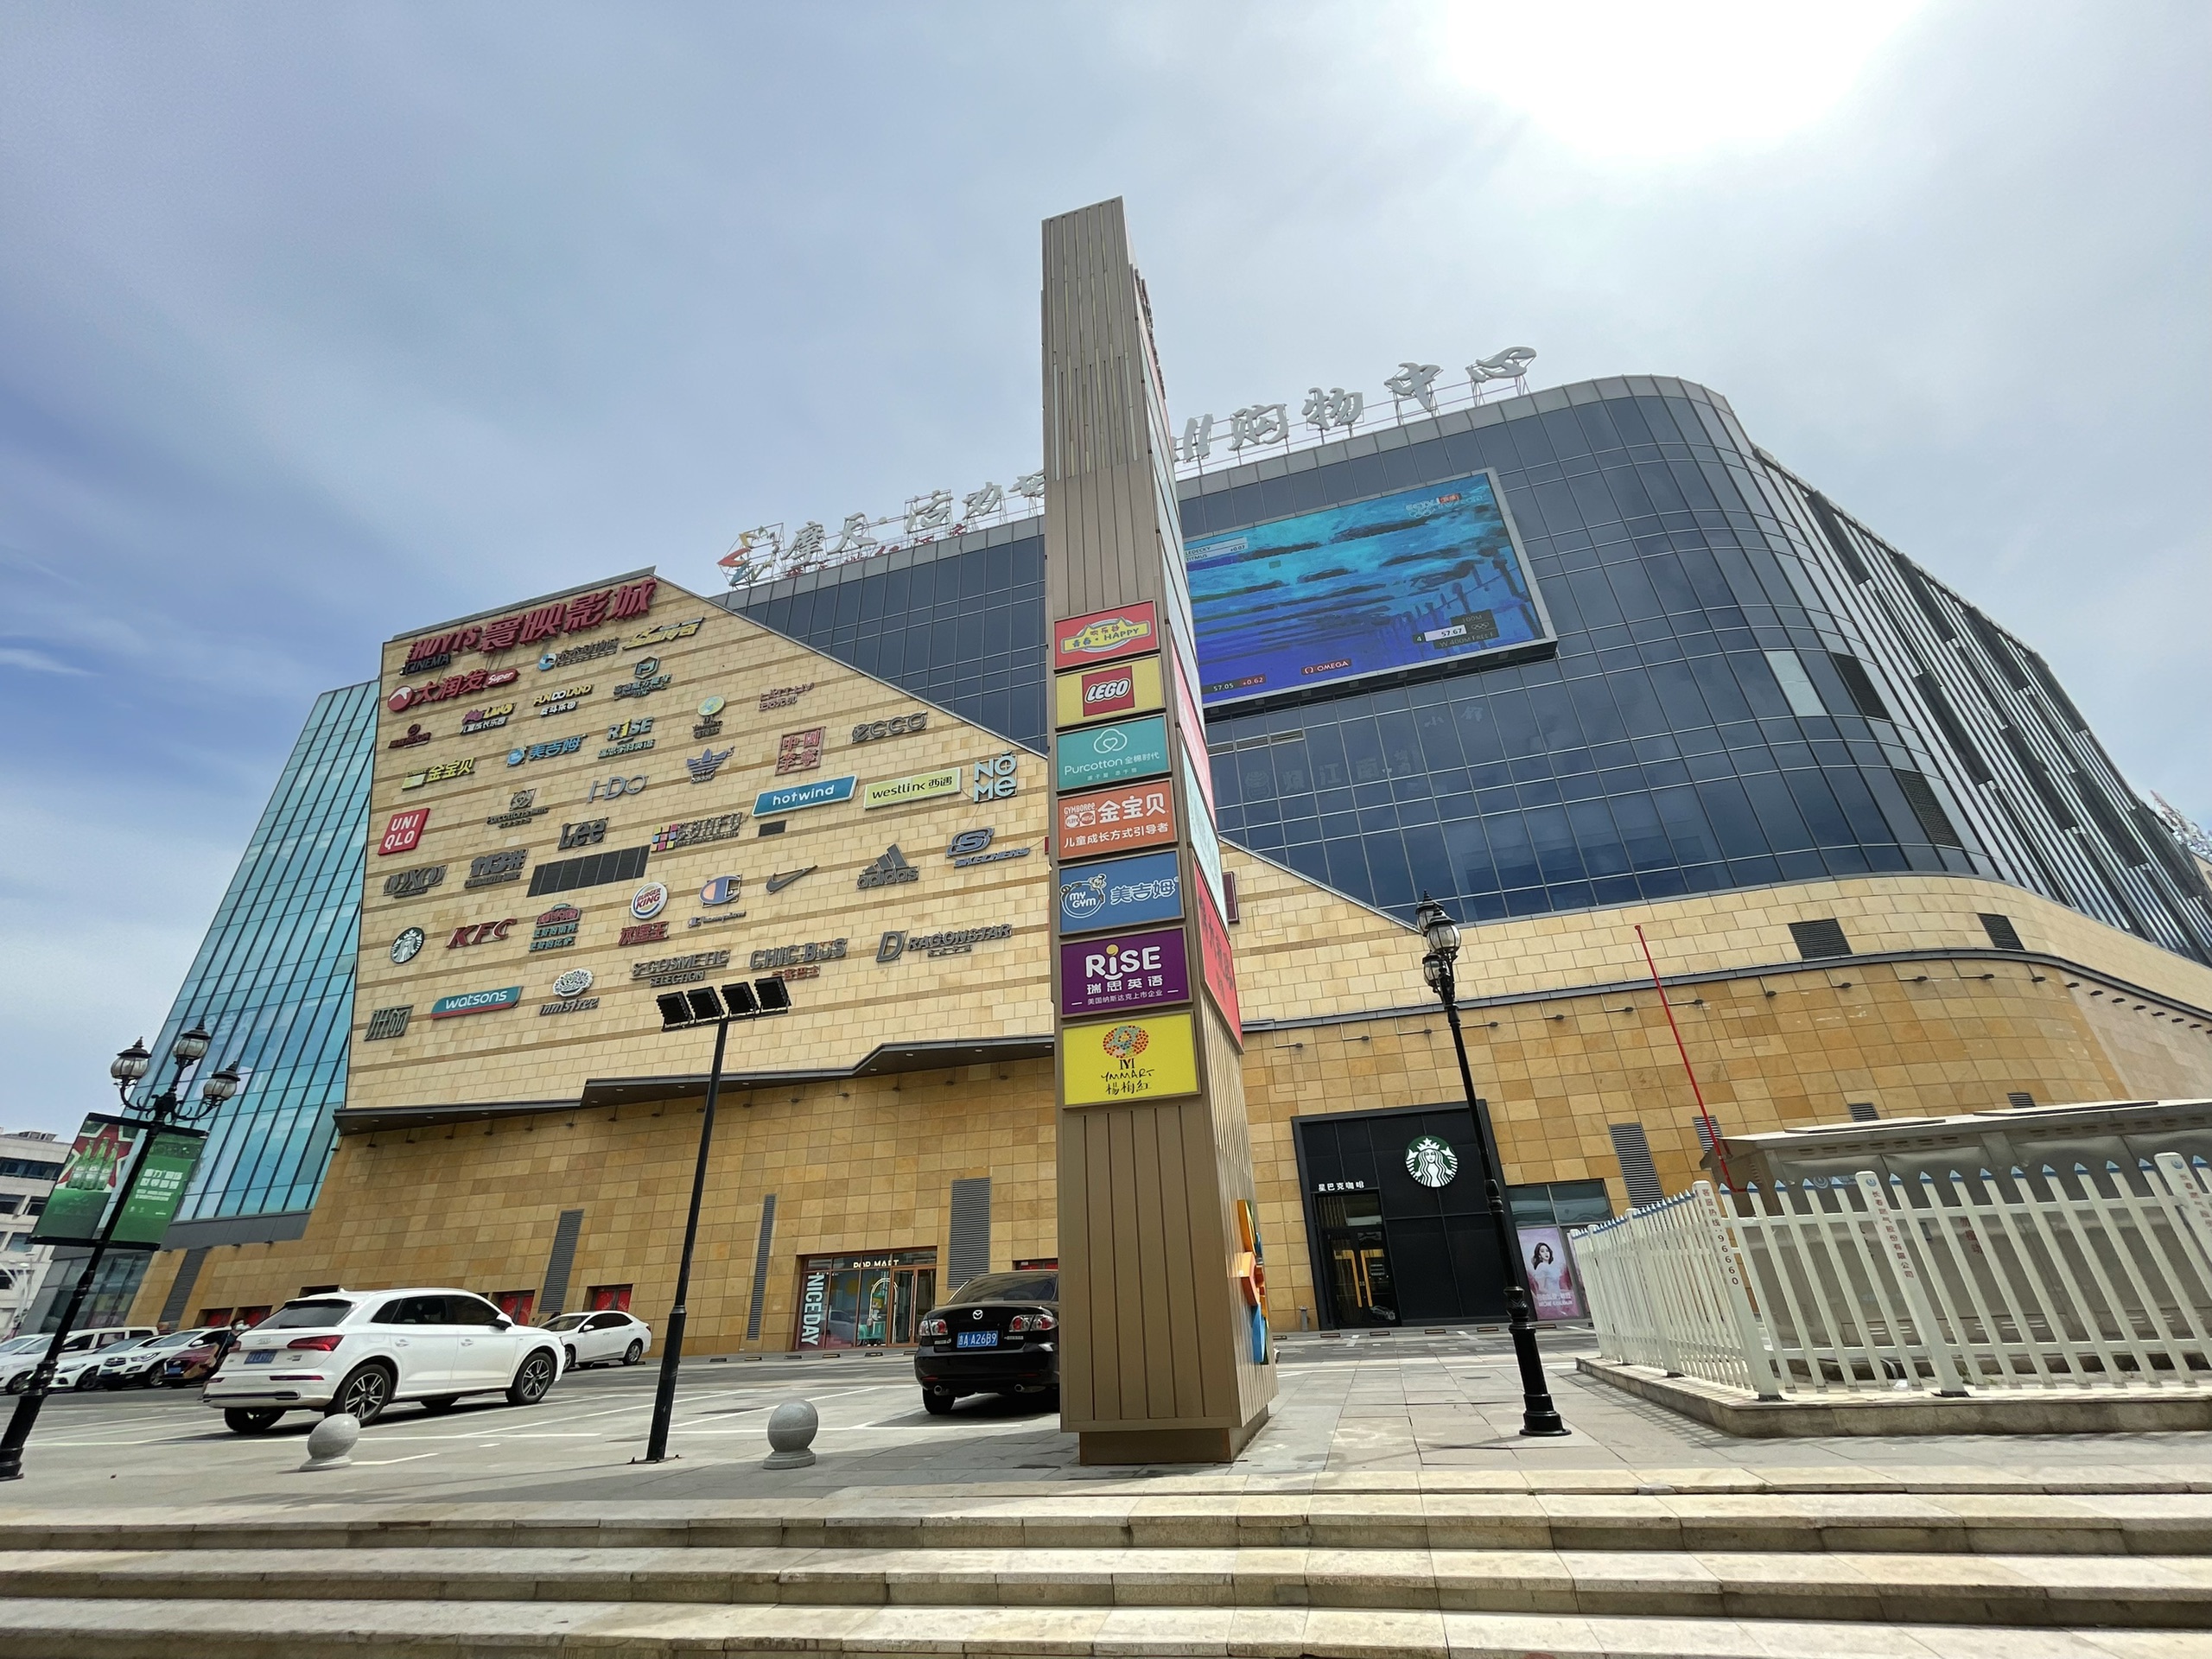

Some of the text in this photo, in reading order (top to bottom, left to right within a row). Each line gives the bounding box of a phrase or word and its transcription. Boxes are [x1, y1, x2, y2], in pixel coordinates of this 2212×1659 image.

[409, 625, 482, 661] HOYTS
[1103, 627, 1140, 641] HAPPY
[1440, 627, 1463, 638] 57.67
[405, 653, 452, 675] CINEMA
[1316, 660, 1350, 672] OMEGA
[411, 669, 514, 705] 大润发 Super
[1085, 677, 1132, 704] LEGO
[1212, 677, 1264, 692] 57.05 +0.62
[852, 710, 928, 744] ecco
[426, 757, 475, 783] 金宝贝
[1064, 758, 1123, 776] Purcotton
[772, 785, 836, 807] hotwind
[871, 782, 925, 800] westlink
[1096, 792, 1167, 824] 金宝贝
[391, 814, 420, 832] UNI
[558, 817, 609, 851] Lee
[384, 830, 416, 850] QLO
[1064, 822, 1169, 849] 儿童成长方式引导者
[856, 866, 919, 889] adidas
[636, 893, 661, 909] KING
[1109, 879, 1176, 906] 美吉姆
[446, 918, 518, 950] KFC
[618, 920, 670, 947] 汉堡王
[749, 938, 849, 970] CHIC BUS
[1086, 975, 1164, 995] 瑞思英语
[445, 988, 509, 1010] watsons
[539, 996, 601, 1017] innisfree
[1087, 989, 1164, 1006] 美国纳斯达克上市企业
[1318, 1179, 1365, 1192] 星巴克咖啡
